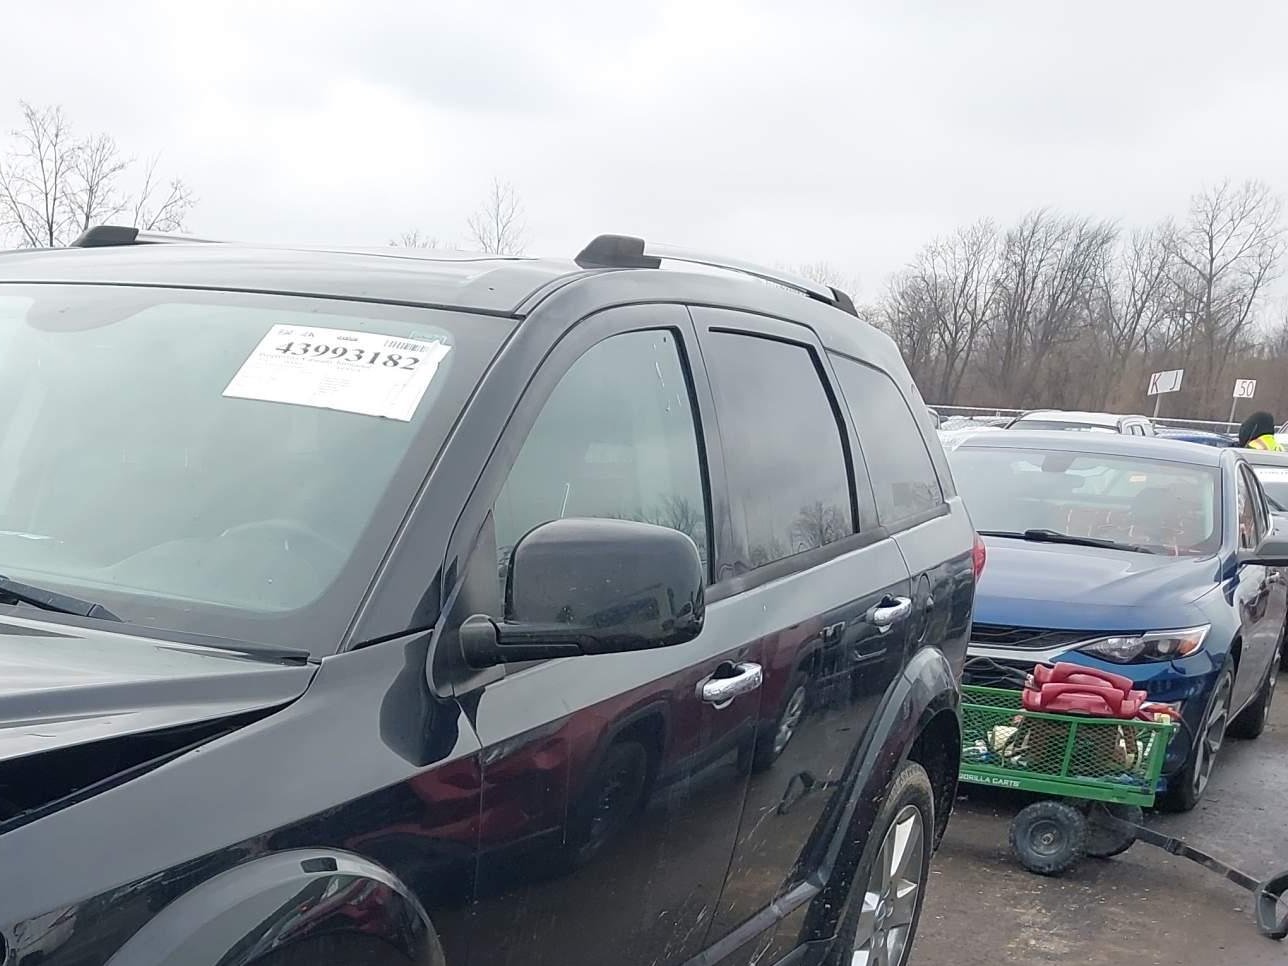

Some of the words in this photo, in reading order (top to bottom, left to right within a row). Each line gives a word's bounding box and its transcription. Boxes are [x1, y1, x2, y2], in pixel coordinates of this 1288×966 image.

[275, 341, 420, 371] 43993182
[1151, 372, 1162, 393] K
[1169, 370, 1179, 391] J
[1238, 381, 1254, 397] 50
[992, 777, 1020, 788] CARTS
